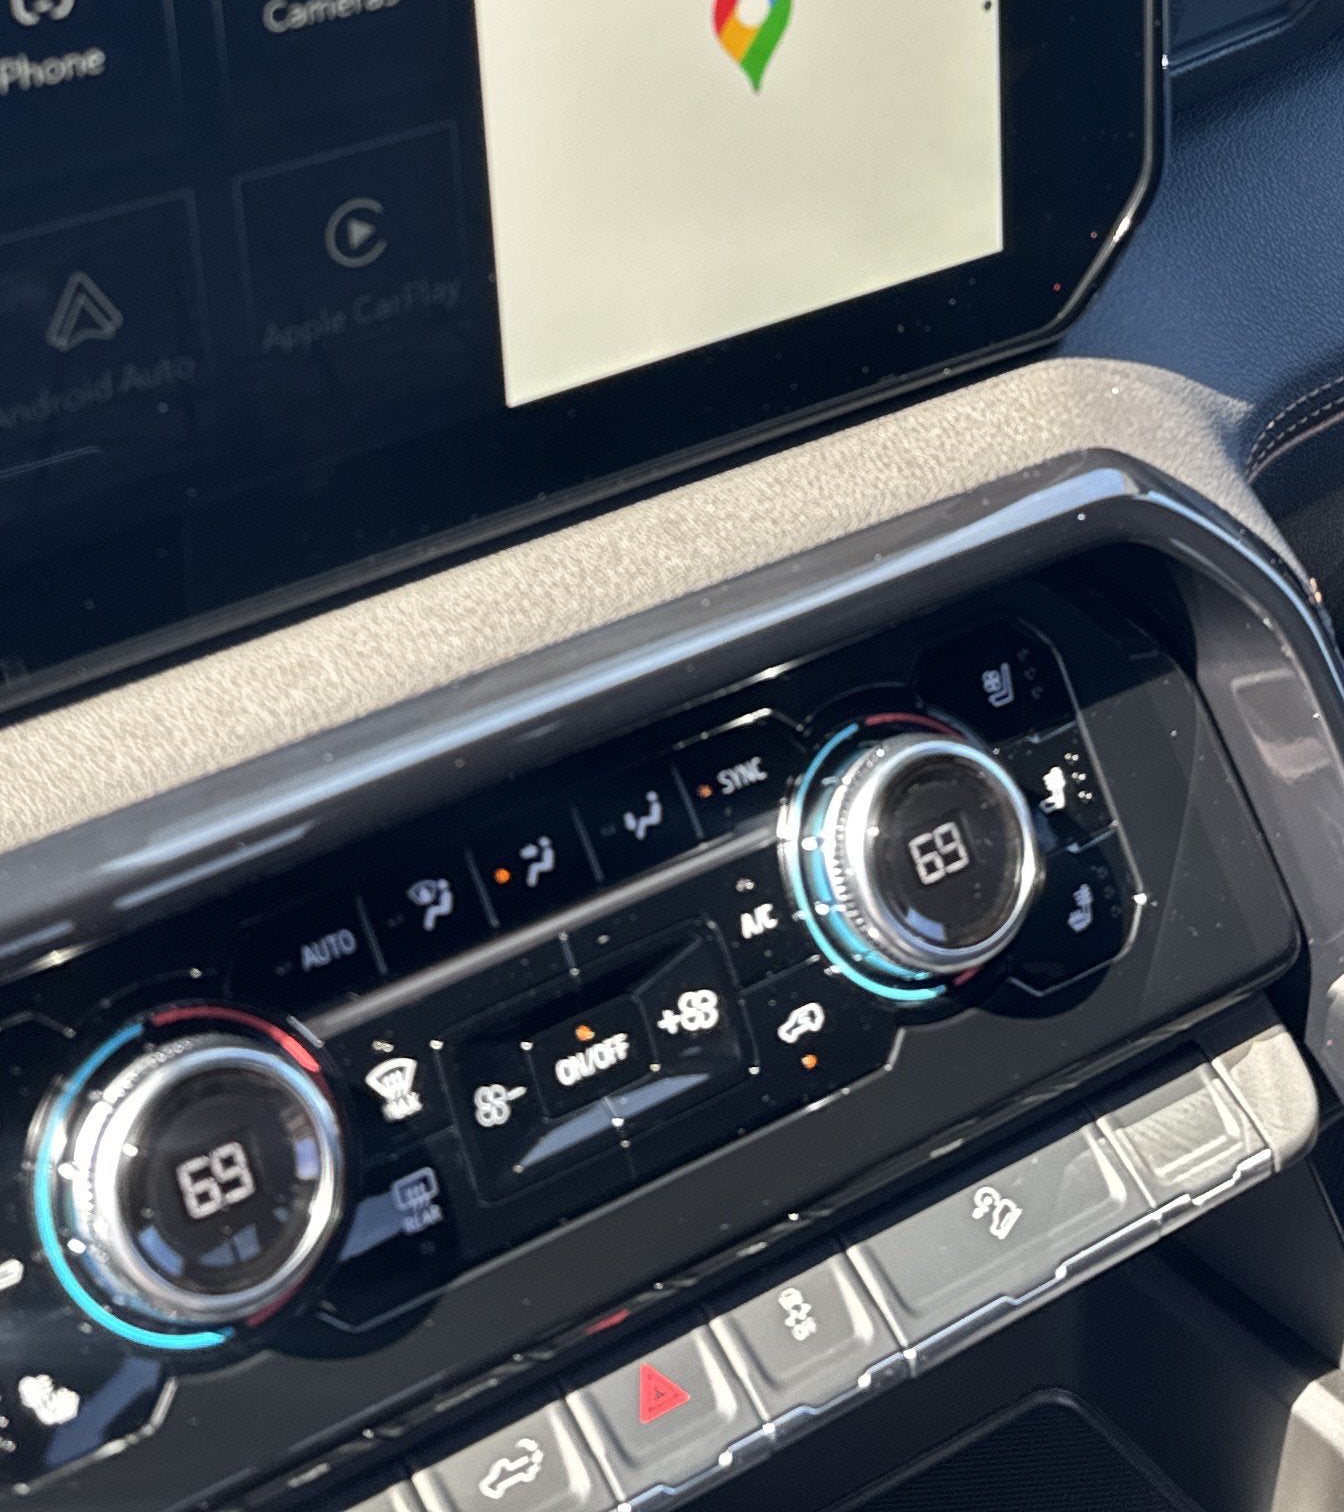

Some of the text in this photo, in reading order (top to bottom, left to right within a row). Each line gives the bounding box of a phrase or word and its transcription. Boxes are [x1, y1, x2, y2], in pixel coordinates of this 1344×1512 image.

[263, 307, 348, 354] Apple
[122, 355, 197, 391] Auto
[716, 756, 768, 795] SYNC
[908, 821, 970, 886] 69
[300, 928, 357, 972] AUTO
[555, 1032, 630, 1086] ON/OFF
[176, 1140, 255, 1220] 69
[404, 1204, 443, 1234] REAR
